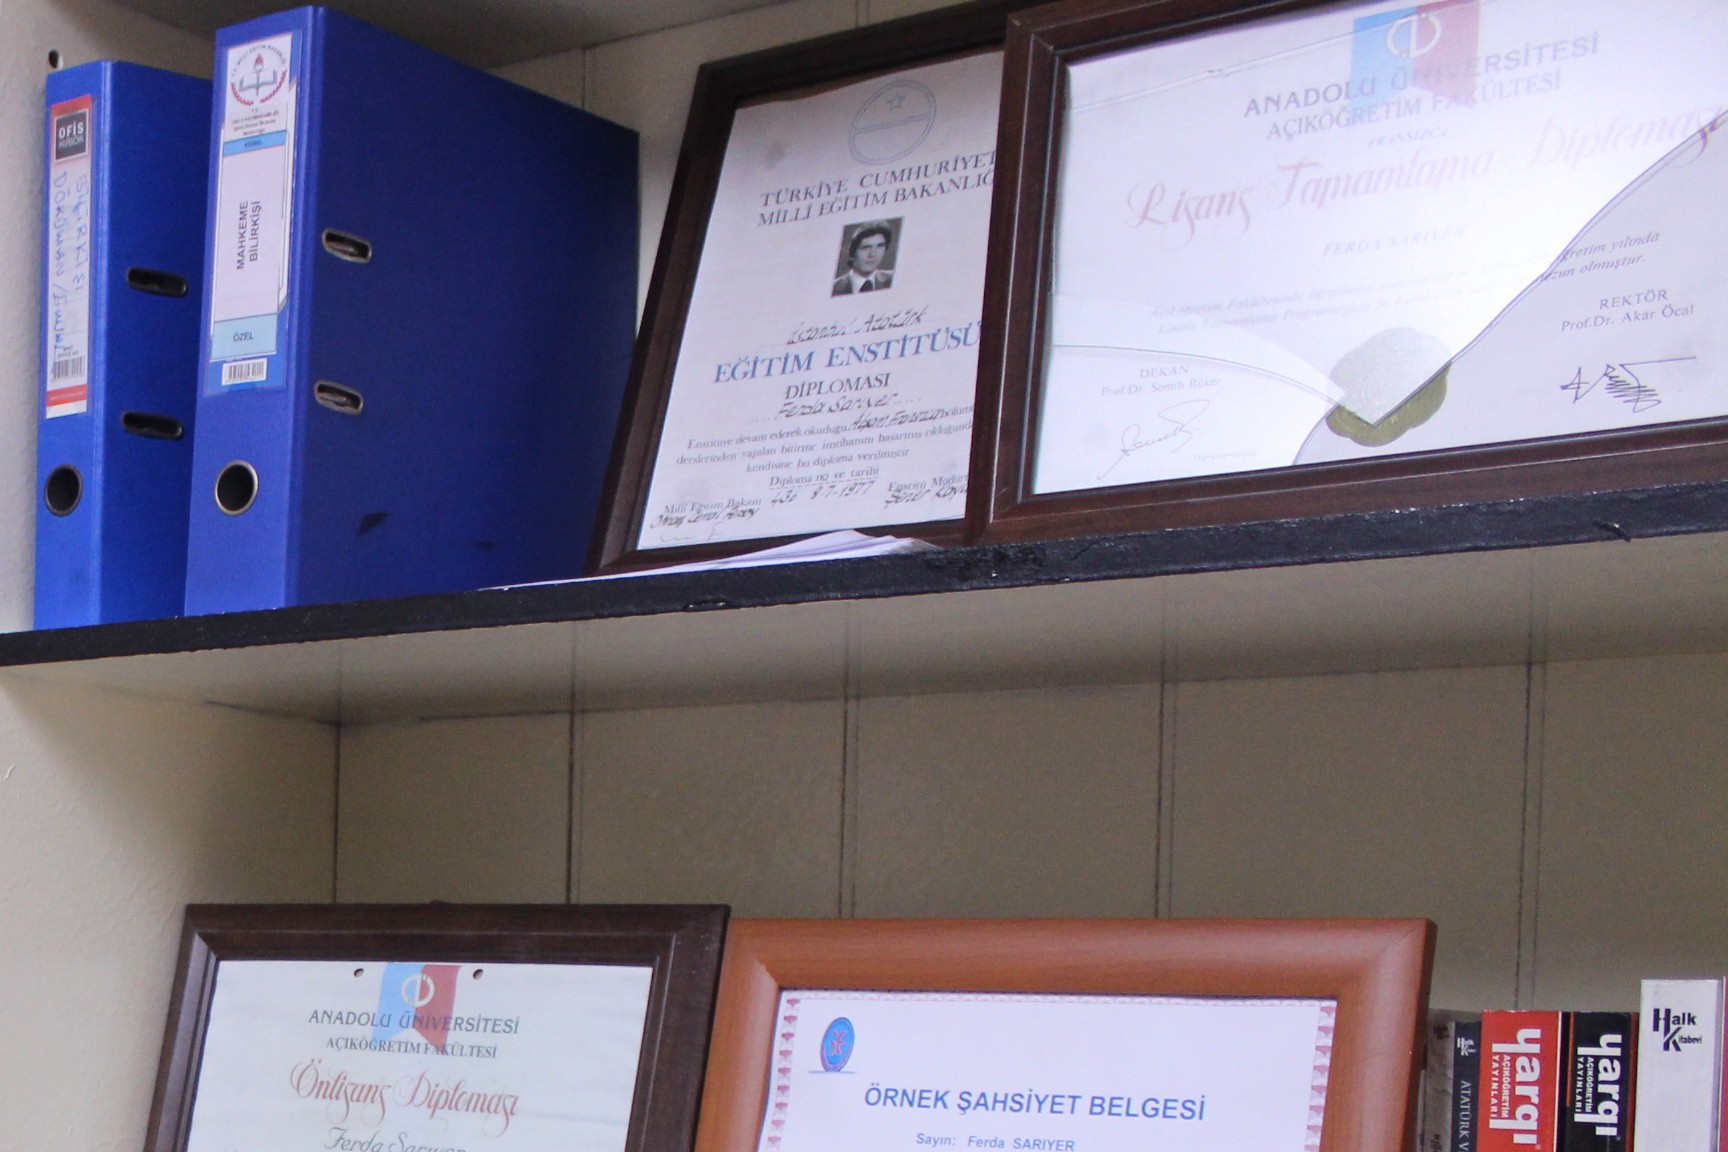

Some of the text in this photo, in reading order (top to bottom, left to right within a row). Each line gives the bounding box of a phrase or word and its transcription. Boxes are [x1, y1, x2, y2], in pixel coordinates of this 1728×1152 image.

[1244, 76, 1377, 118] ANADOLU
[58, 121, 85, 139] OFİS
[1267, 96, 1421, 141] AÇIKÖĞRETİM
[757, 203, 812, 227] MİLLİ
[818, 192, 888, 217] EĞİTİM
[761, 180, 849, 207] TÜRKİYE
[236, 200, 249, 270] MAHKEME
[249, 200, 262, 262] BİLİRKİŞİ
[1611, 232, 1660, 253] yılında
[1580, 253, 1646, 274] olmuştur.
[1599, 289, 1668, 309] REKTÖR
[1621, 309, 1656, 323] Akar
[1662, 305, 1695, 318] Öcal
[233, 332, 255, 342] ÖZEL
[713, 321, 983, 383] EĞİTİM ENSTİTÜSÜ
[784, 373, 891, 400] DİPLOMASI
[1140, 365, 1190, 378] DEKAN
[813, 454, 853, 466] diploma
[769, 475, 813, 487] Diploma
[309, 1010, 520, 1034] ANADOLU ÜNİVERSİTESİ
[327, 1037, 497, 1059] AÇIKÖĞRETİM FAKÜLTESİ
[290, 1058, 521, 1139] Önlisans Diploması
[864, 1082, 1206, 1121] ÖRNEK ŞAHSİYET BELGESİ
[1489, 1028, 1542, 1144] yargı
[1490, 1055, 1500, 1117] YAYINLARI
[1501, 1054, 1512, 1118] AÇIKÖĞRETİM
[1574, 1033, 1623, 1136] yargı
[1575, 1056, 1584, 1112] YAYINLARI
[1585, 1056, 1594, 1113] AÇIKÖĞRETİM
[1459, 1080, 1473, 1137] ATATÜRK
[915, 1132, 1075, 1152] Sayın: Ferda SARIYER
